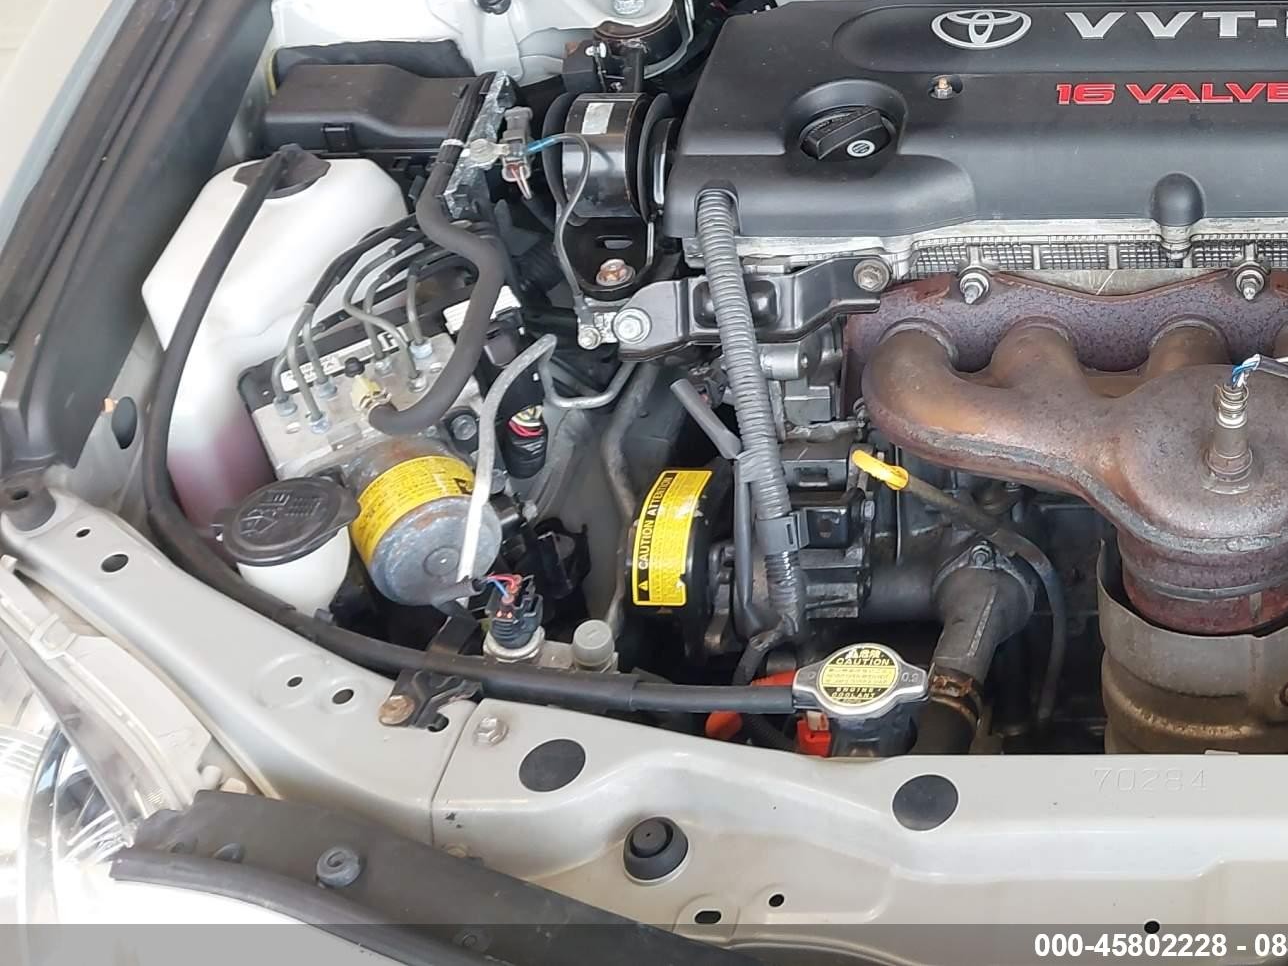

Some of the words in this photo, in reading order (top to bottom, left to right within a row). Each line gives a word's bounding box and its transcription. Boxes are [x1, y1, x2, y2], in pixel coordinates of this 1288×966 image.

[1056, 82, 1116, 105] 16
[638, 520, 654, 570] CAUTION
[835, 657, 890, 666] CAUTION
